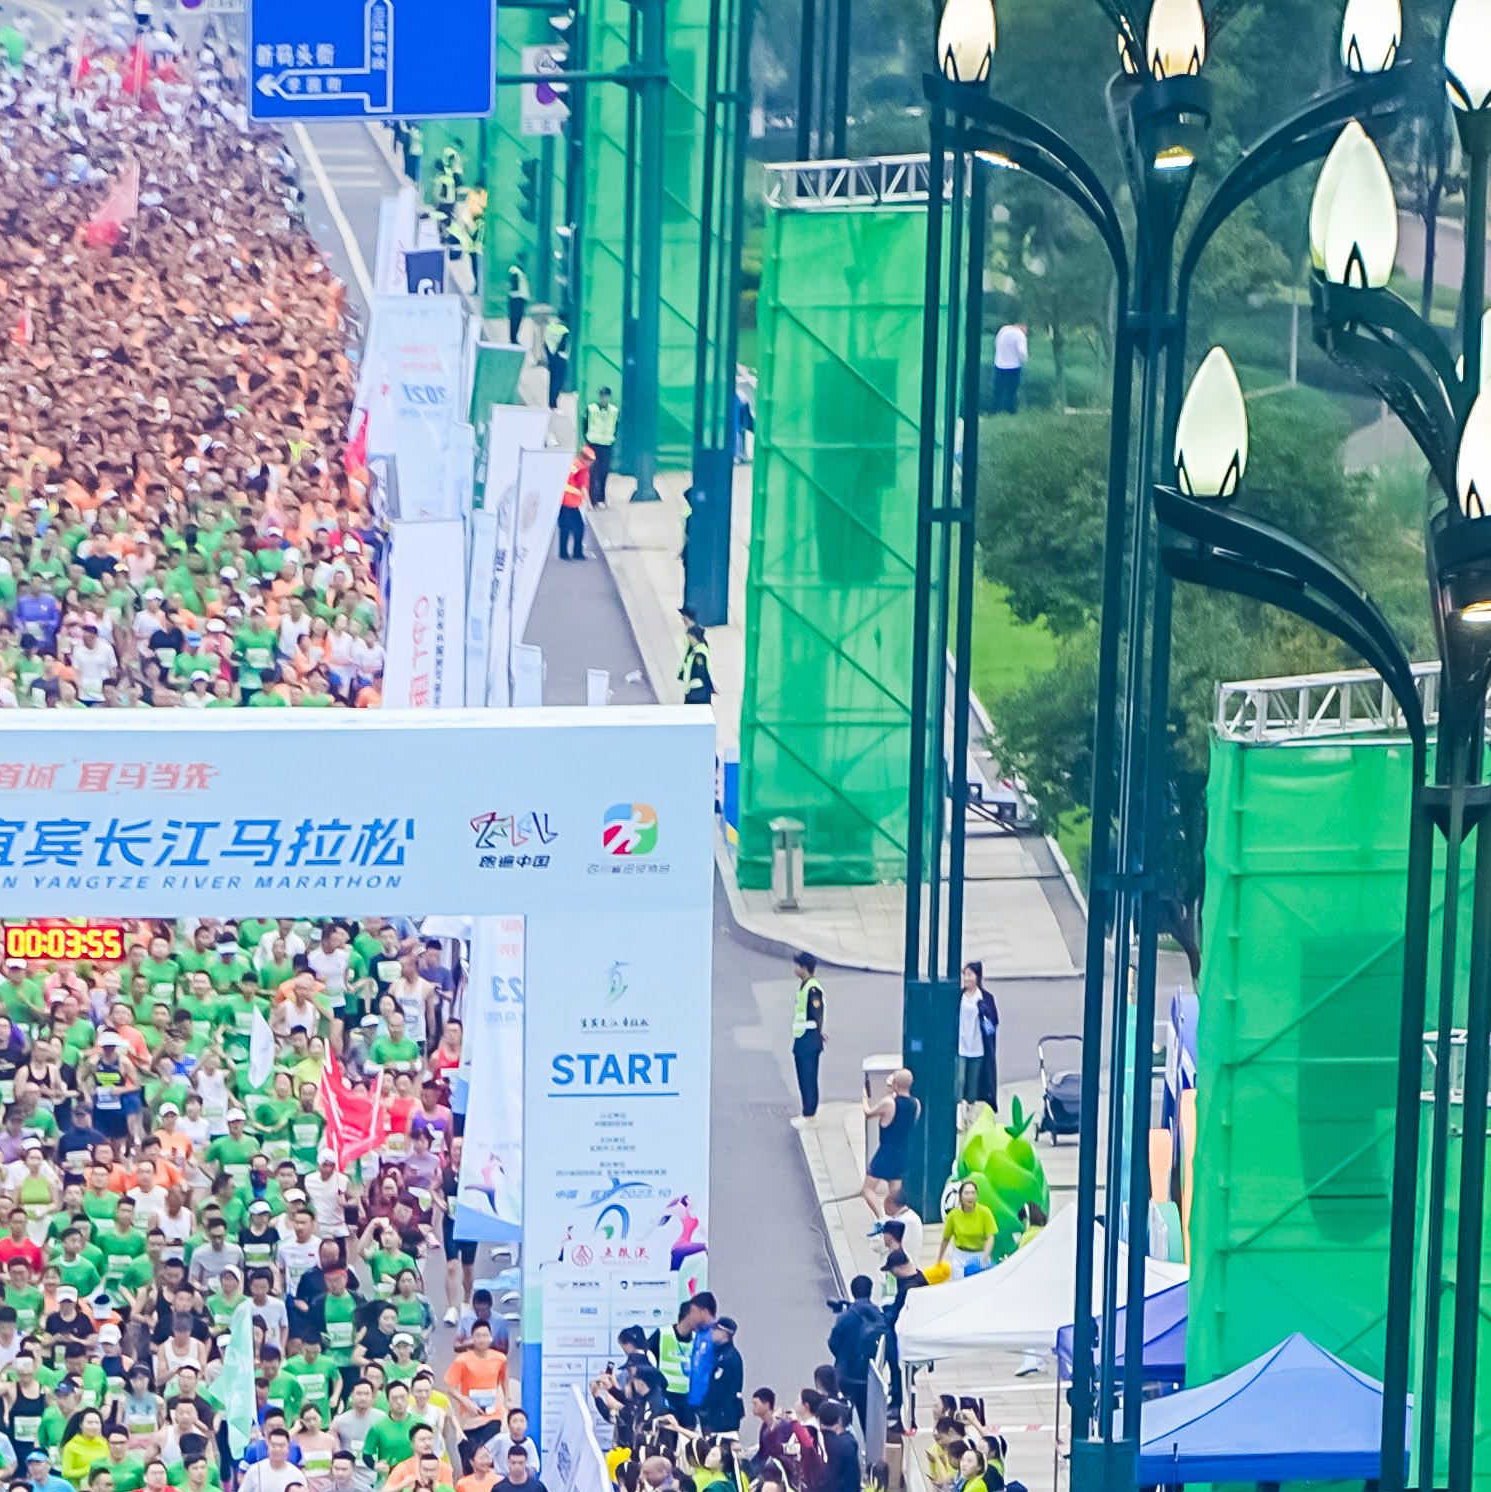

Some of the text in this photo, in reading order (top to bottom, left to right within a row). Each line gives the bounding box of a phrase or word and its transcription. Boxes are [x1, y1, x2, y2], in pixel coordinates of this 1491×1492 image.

[75, 761, 218, 792] 宜马当先
[33, 874, 149, 890] YANGTZE
[161, 874, 241, 890] RIVER
[253, 874, 403, 890] MARATHON
[7, 927, 122, 959] 00:03:55
[551, 1052, 677, 1085] START
